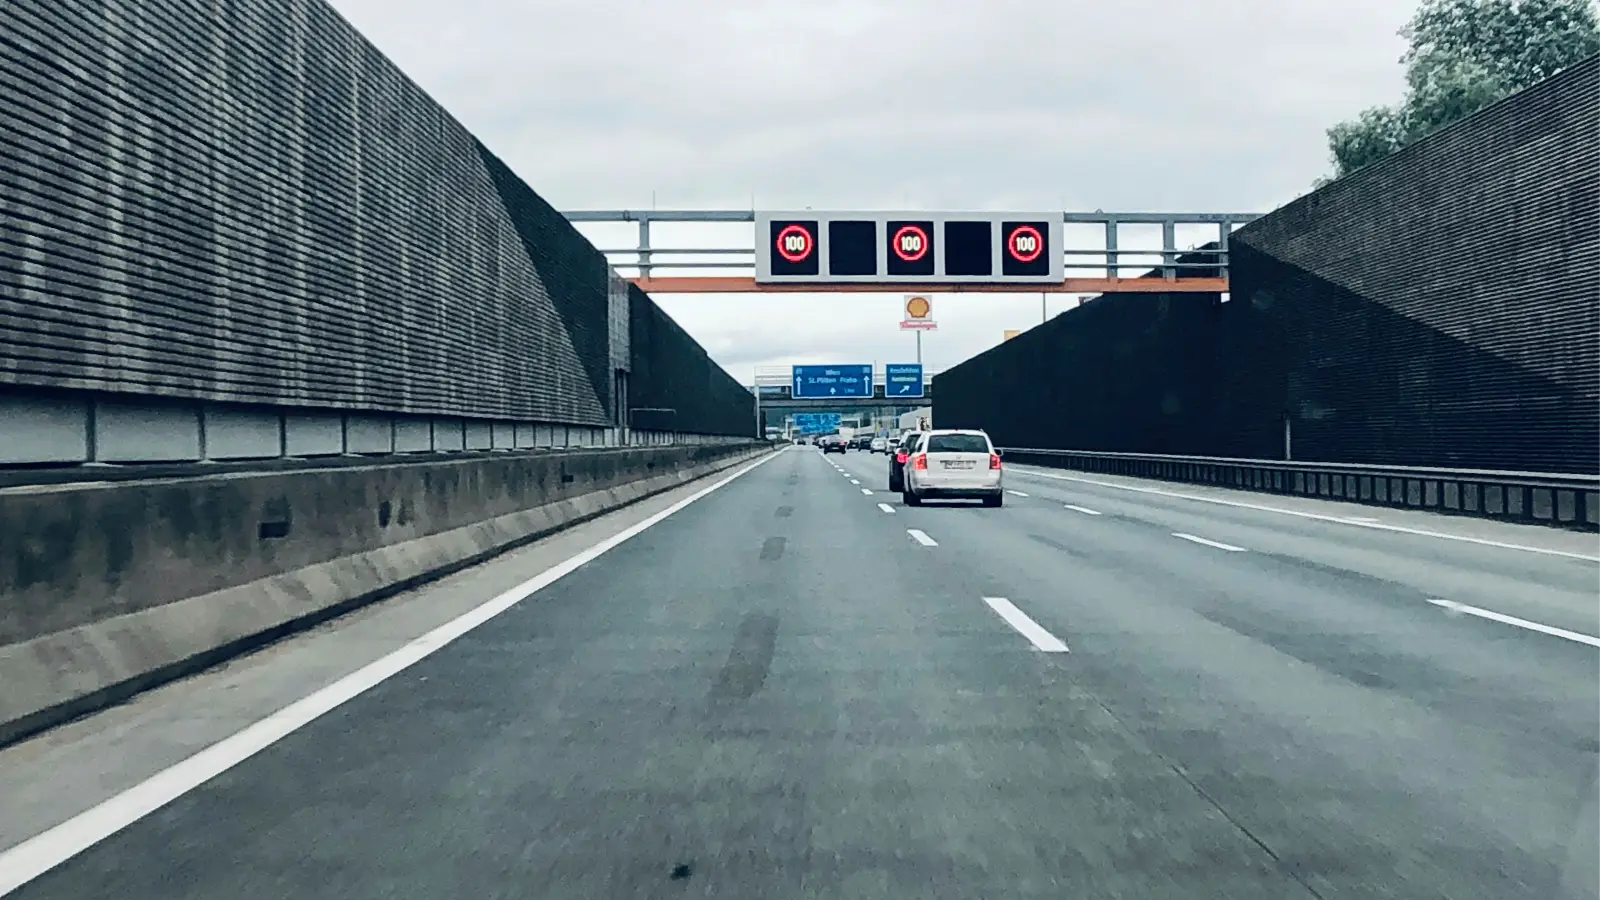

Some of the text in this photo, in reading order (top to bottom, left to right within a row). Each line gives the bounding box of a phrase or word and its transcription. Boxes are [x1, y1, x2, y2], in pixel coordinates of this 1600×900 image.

[785, 236, 804, 250] 100
[901, 236, 920, 250] 100
[1016, 237, 1035, 250] 100
